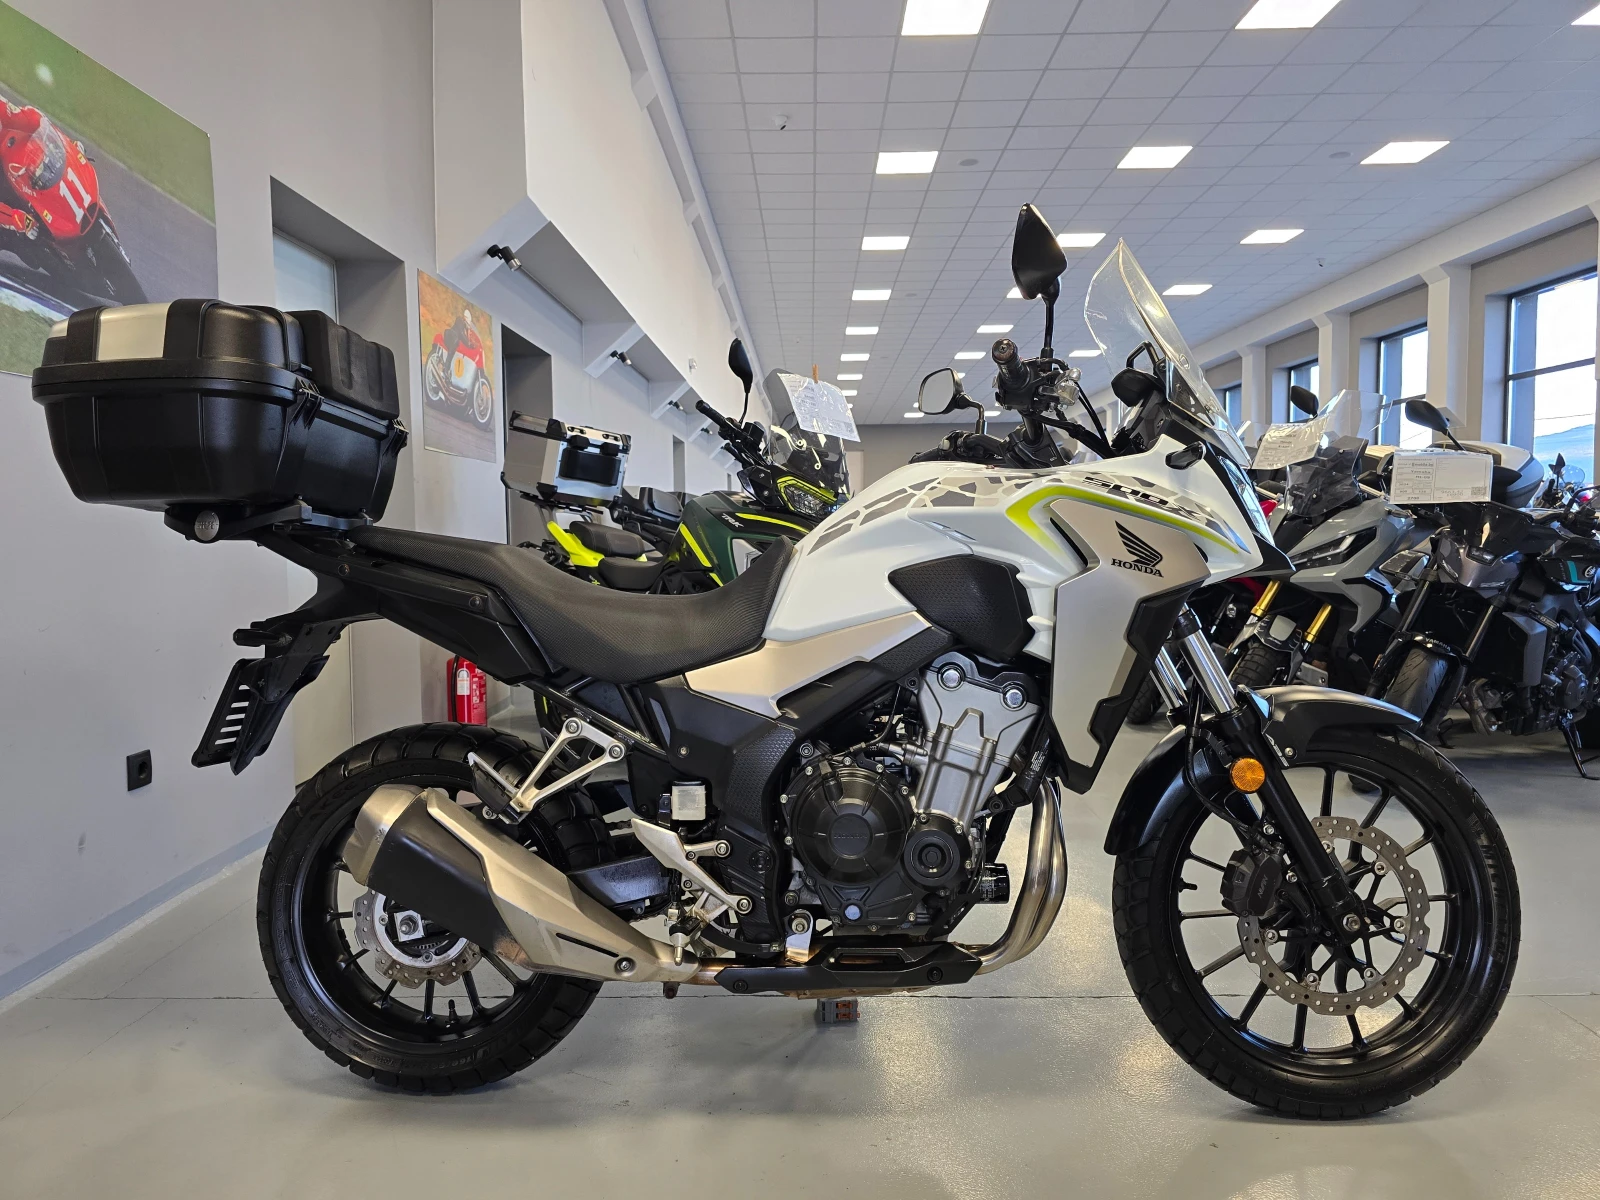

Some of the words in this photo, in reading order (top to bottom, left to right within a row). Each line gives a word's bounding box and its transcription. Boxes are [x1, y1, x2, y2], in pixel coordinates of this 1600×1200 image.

[59, 166, 92, 225] 11
[721, 512, 745, 528] TRK
[1111, 558, 1164, 578] HONDA
[1425, 637, 1451, 651] YAMAHA
